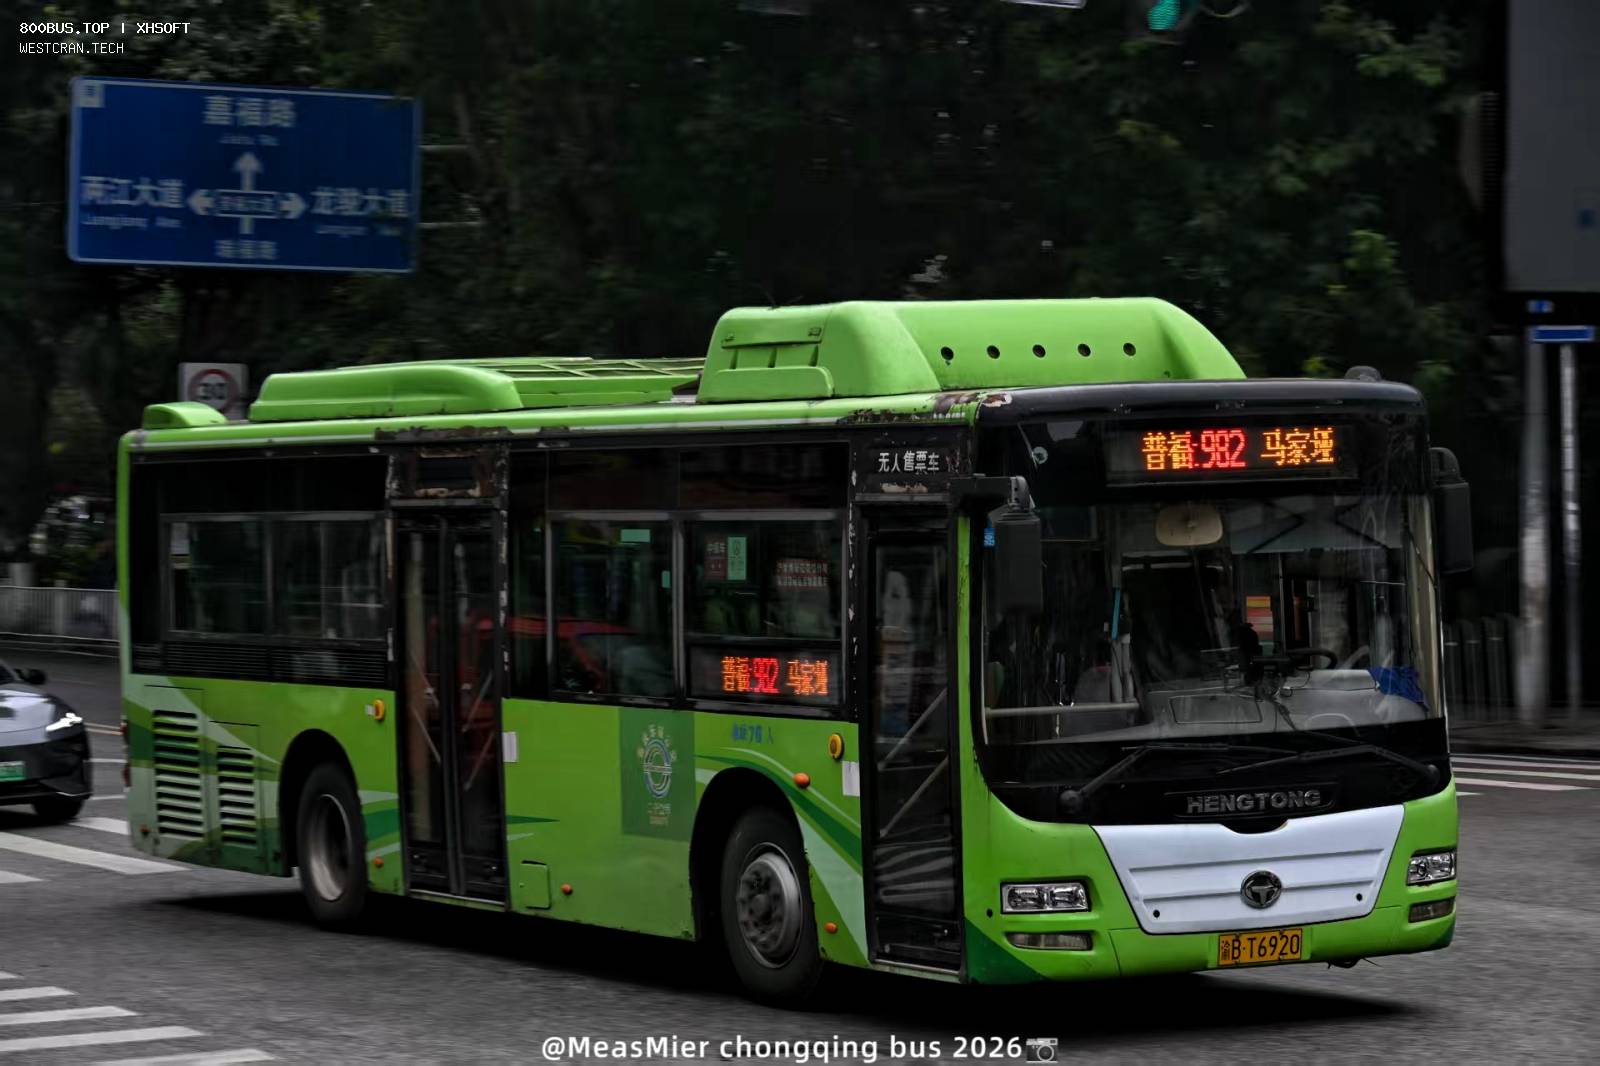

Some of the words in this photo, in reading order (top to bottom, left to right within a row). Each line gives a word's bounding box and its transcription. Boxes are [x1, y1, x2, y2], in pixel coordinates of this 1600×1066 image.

[81, 176, 184, 208] 两江大道
[878, 450, 940, 475] 无人售票车
[1186, 790, 1321, 814] HENGTONG
